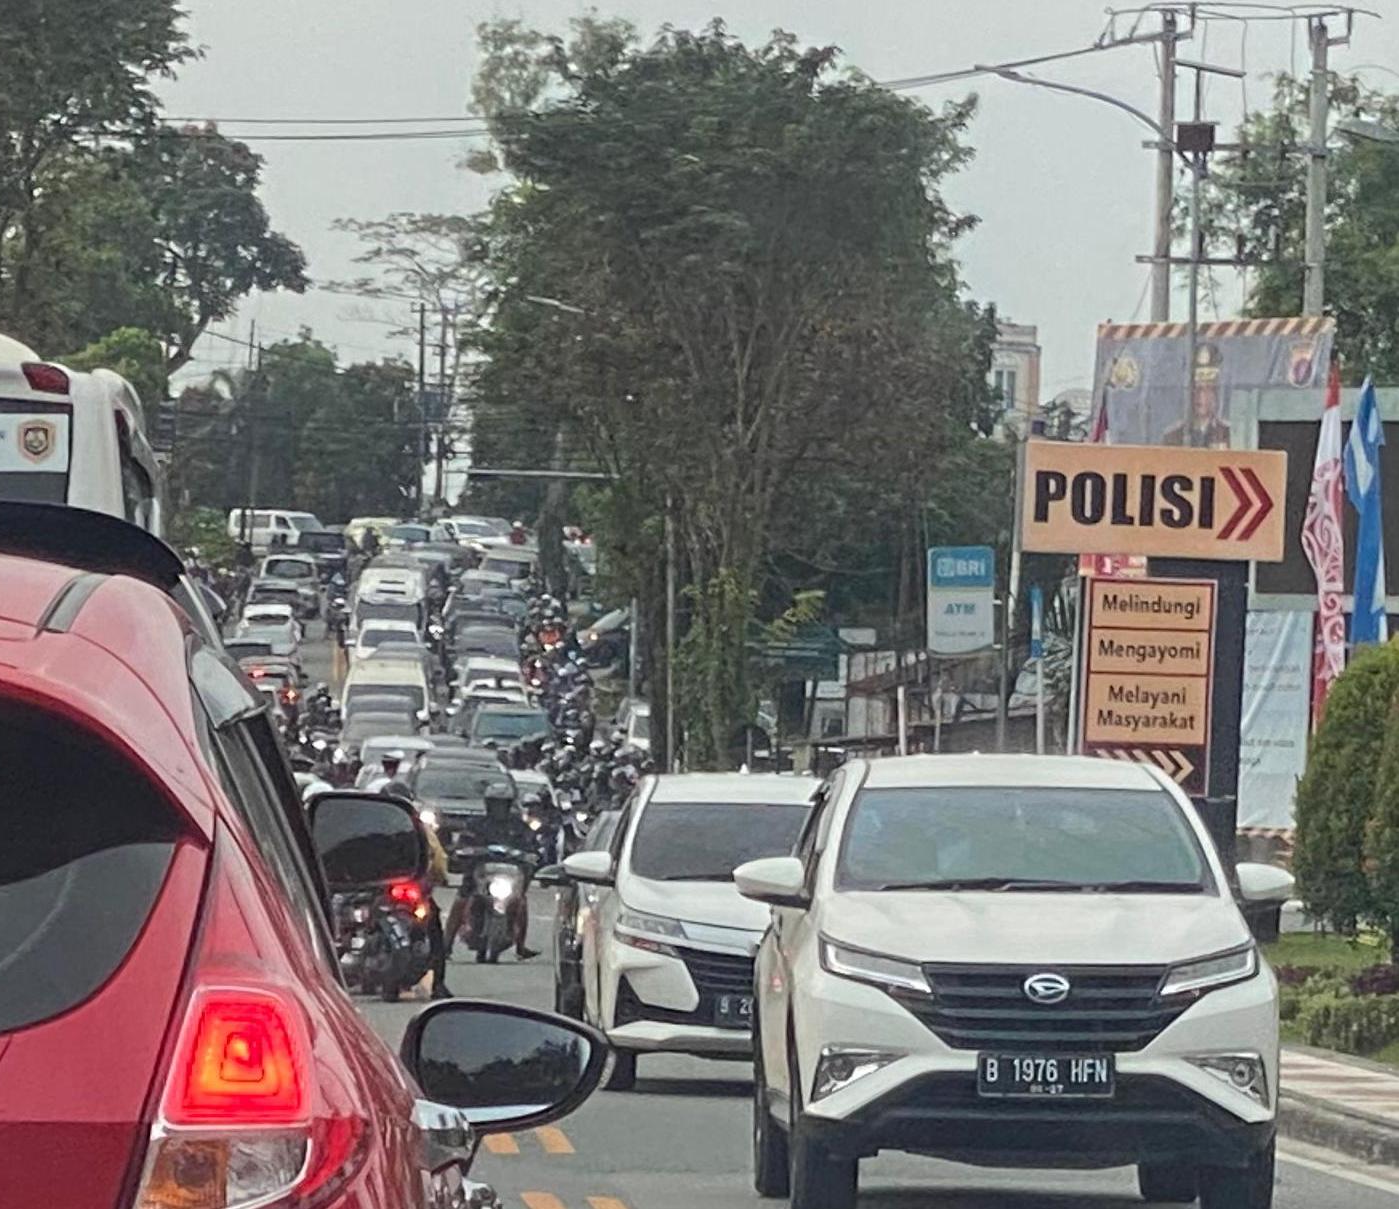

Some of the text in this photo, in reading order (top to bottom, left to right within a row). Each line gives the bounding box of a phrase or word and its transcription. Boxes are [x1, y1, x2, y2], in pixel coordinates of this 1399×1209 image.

[1034, 470, 1215, 529] POLISI
[956, 559, 986, 576] BRI
[1102, 594, 1200, 619] Melindungi
[1098, 639, 1201, 664] Mengayomi
[1108, 685, 1187, 709] Melayani
[1096, 709, 1195, 732] Masyarakat
[986, 1058, 1107, 1082] B 1976 HFN
